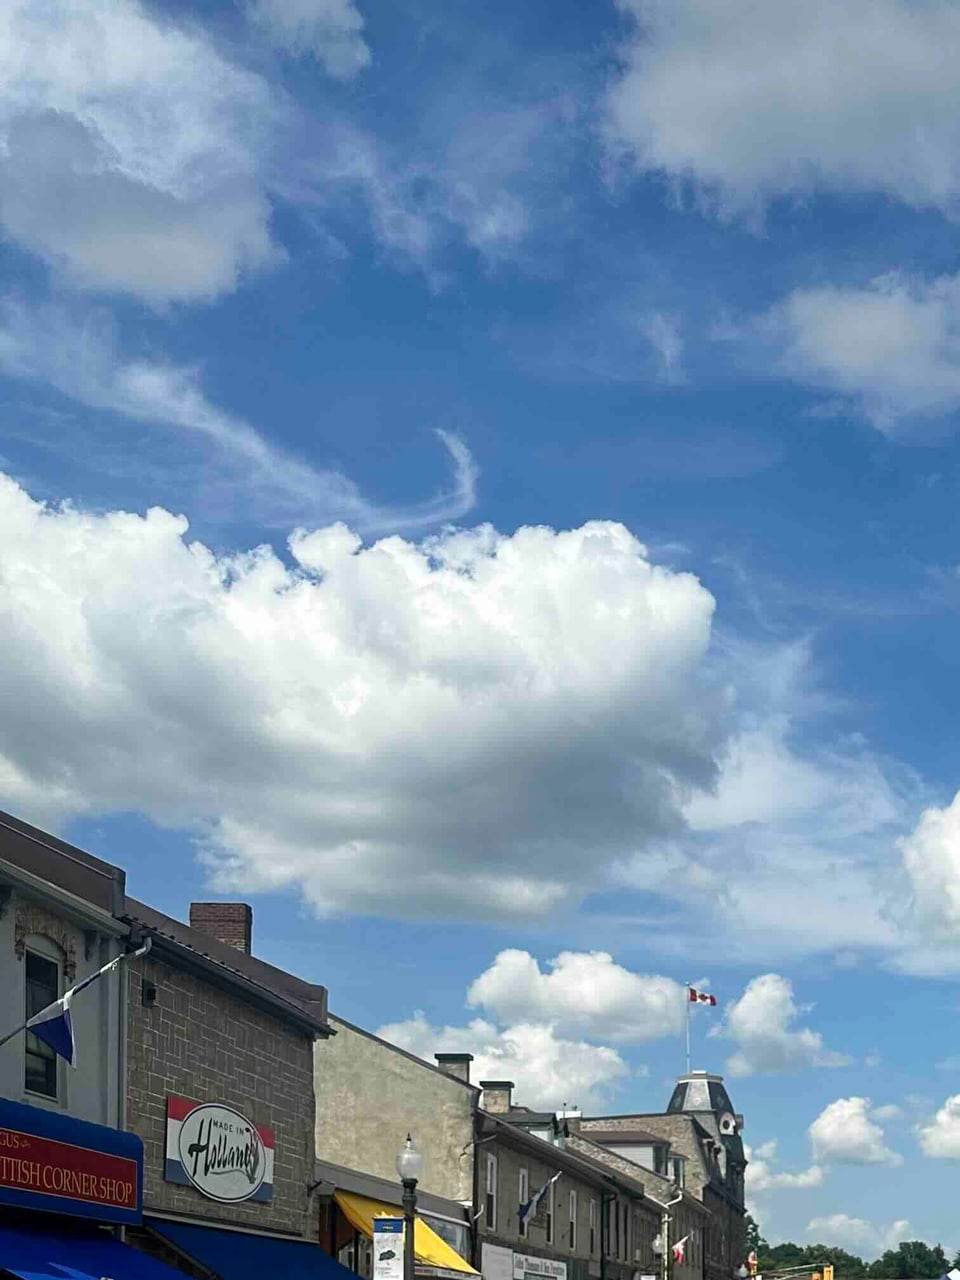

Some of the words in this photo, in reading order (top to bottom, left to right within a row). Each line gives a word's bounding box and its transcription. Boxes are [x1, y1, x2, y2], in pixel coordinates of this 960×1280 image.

[213, 1120, 233, 1132] MADE
[236, 1126, 244, 1135] IN
[188, 1117, 257, 1179] Holland
[43, 1165, 99, 1198] CORNER
[100, 1177, 133, 1203] SHOP
